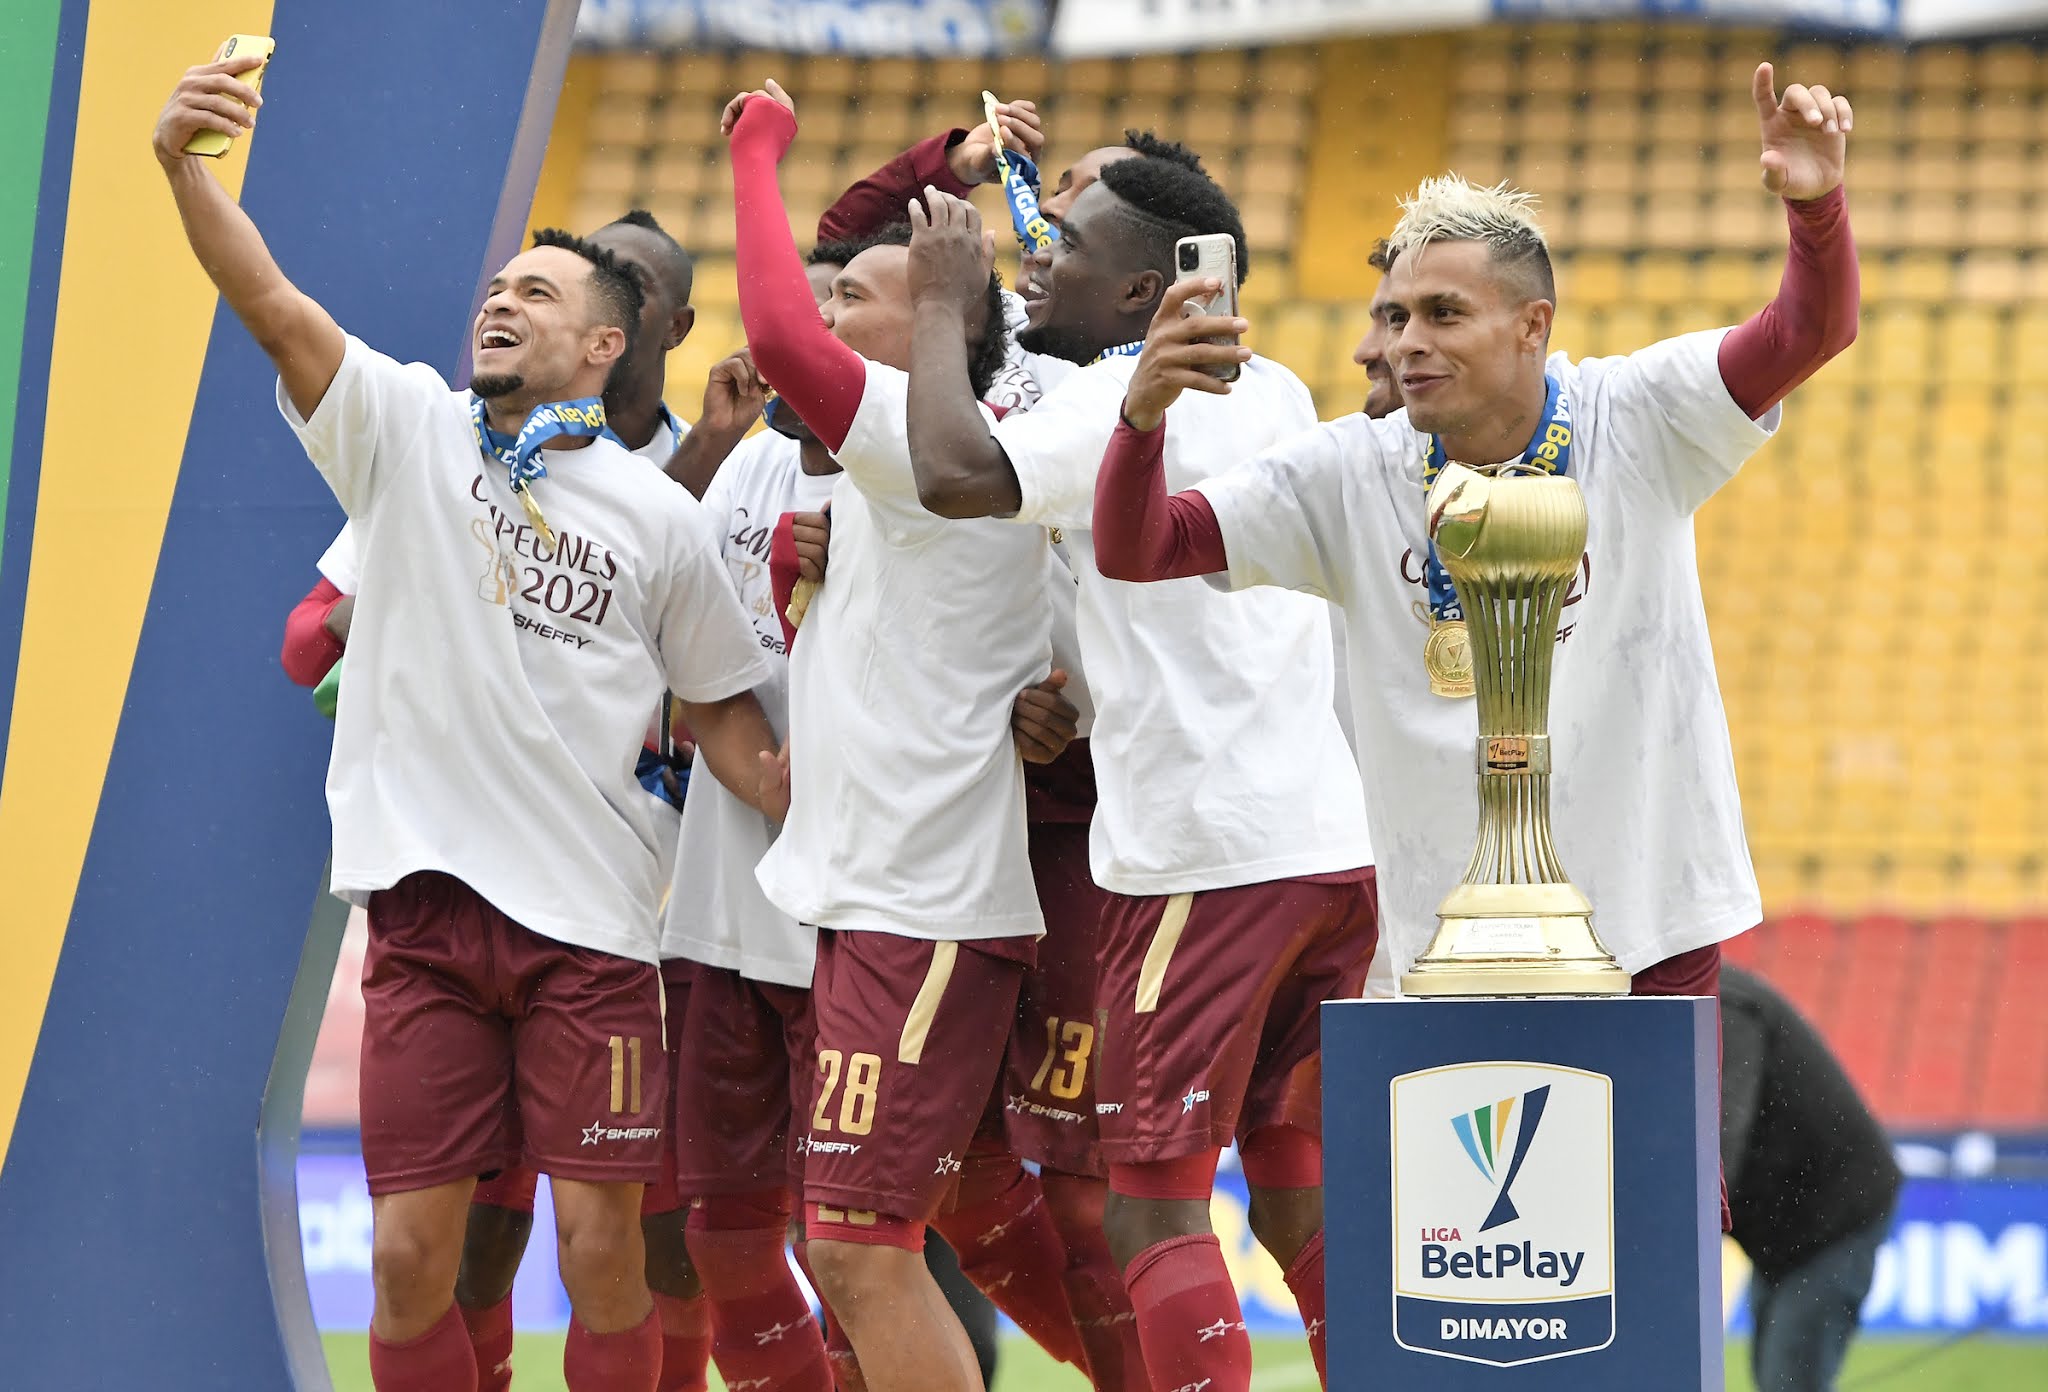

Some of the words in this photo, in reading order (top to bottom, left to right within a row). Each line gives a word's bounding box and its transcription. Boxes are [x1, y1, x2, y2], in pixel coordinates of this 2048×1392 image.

[521, 567, 613, 626] 2021
[513, 613, 592, 650] SHEFFY
[608, 1035, 641, 1113] 11
[1030, 1016, 1094, 1100] 13
[812, 1050, 882, 1135] 28
[1029, 1104, 1087, 1125] SHEFFY
[606, 1128, 661, 1140] SHEFFY
[813, 1141, 861, 1155] SHEFFY
[1421, 1228, 1462, 1242] LIGA
[1422, 1240, 1585, 1287] BetPlay
[1440, 1318, 1568, 1340] DIMAYOR
